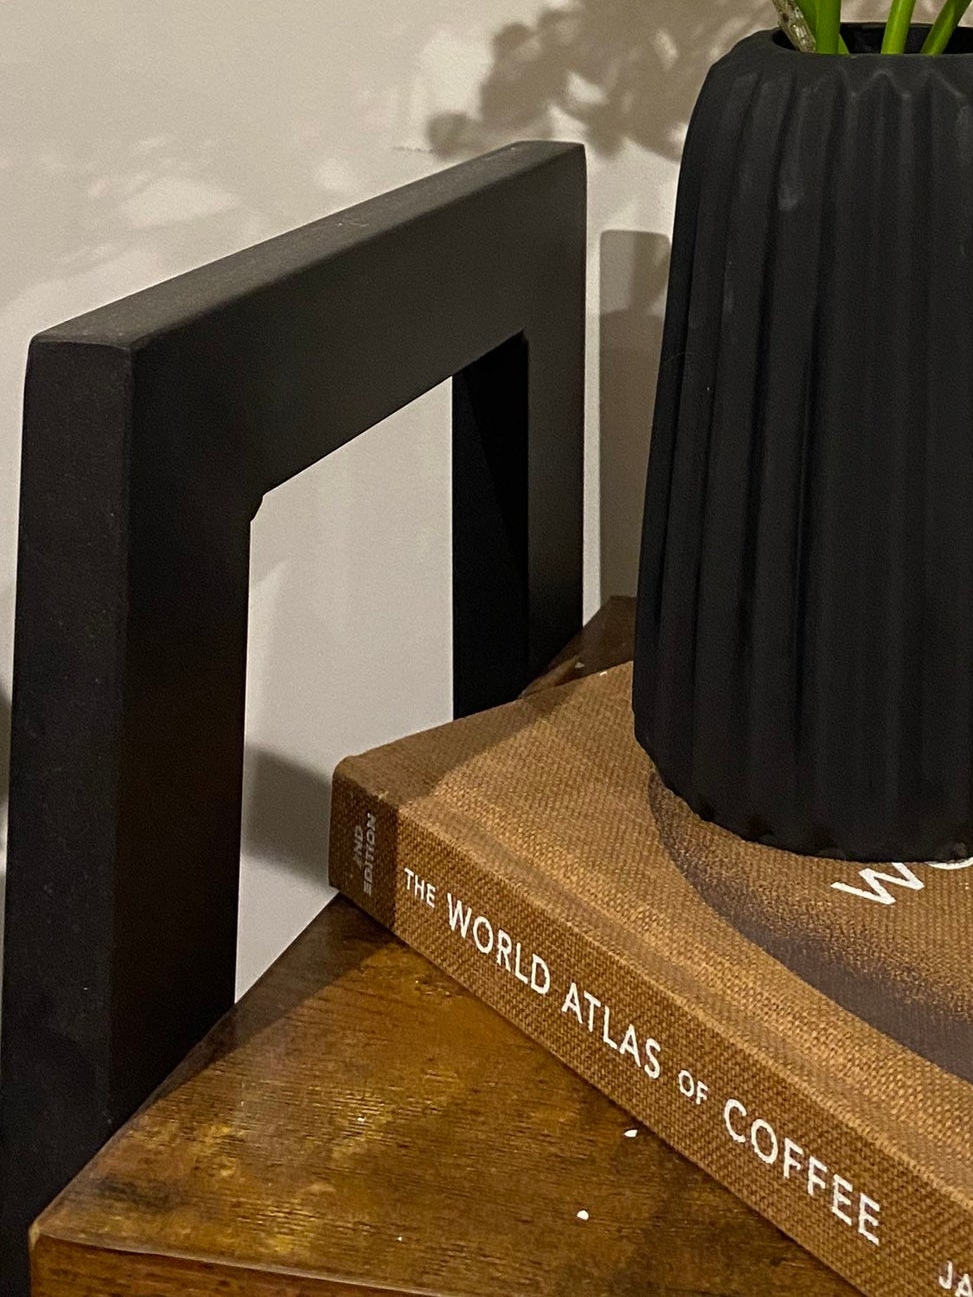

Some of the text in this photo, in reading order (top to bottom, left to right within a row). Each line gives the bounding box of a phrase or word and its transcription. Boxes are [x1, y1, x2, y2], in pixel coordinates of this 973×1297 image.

[363, 812, 377, 897] EDITION
[404, 867, 436, 908] THE
[447, 892, 552, 996] WORLD
[562, 982, 662, 1080] ATLAS
[678, 1069, 708, 1104] OF
[724, 1099, 880, 1246] COFFEE
